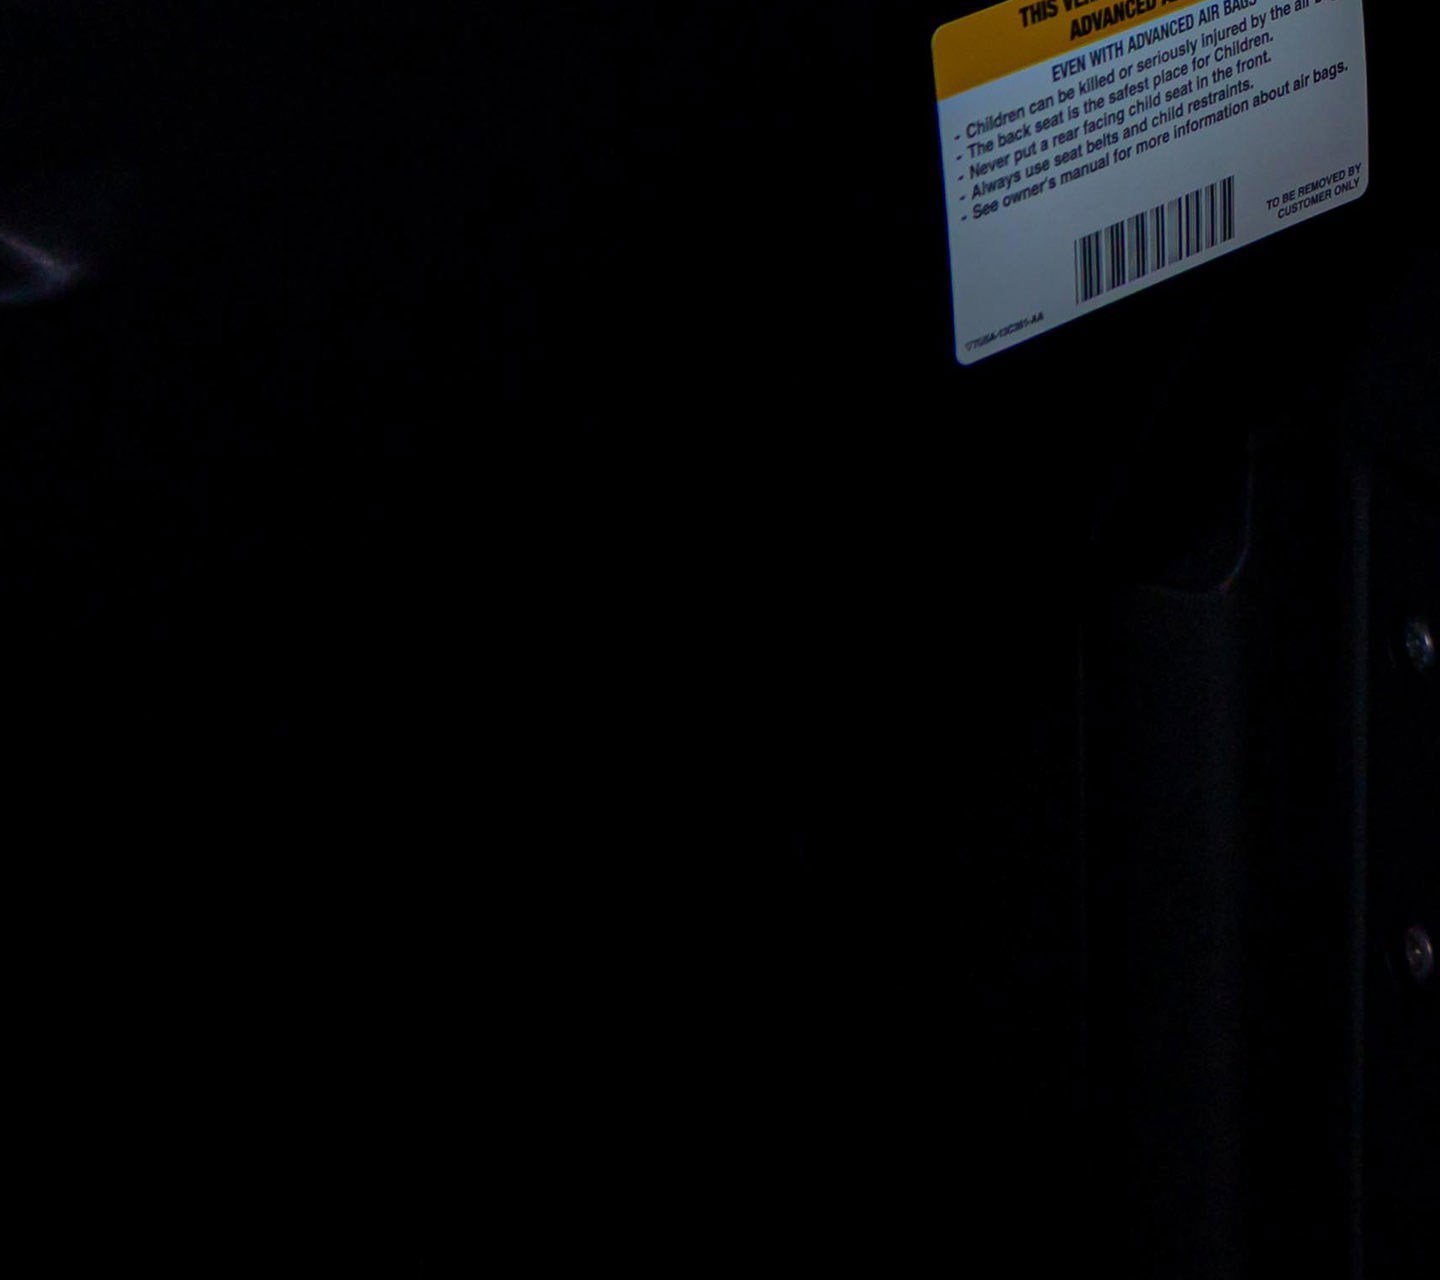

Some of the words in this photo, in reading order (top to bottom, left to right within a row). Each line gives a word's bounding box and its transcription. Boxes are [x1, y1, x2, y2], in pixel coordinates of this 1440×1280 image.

[966, 106, 1026, 139] Children
[1029, 96, 1054, 115] can
[1058, 87, 1075, 103] be
[1079, 71, 1115, 94] killed
[1119, 65, 1133, 80] or
[1137, 39, 1197, 73] seriously
[1201, 17, 1247, 48] injured
[1251, 11, 1267, 29] by
[1270, 4, 1291, 21] the
[967, 138, 994, 159] The
[998, 124, 1031, 148] back
[1035, 112, 1064, 133] seat
[1067, 106, 1079, 121] is
[1084, 96, 1105, 114] the
[1108, 77, 1149, 104] safest
[1153, 63, 1188, 90] place
[1192, 53, 1210, 71] for
[1214, 31, 1274, 63] Children.
[1051, 54, 1086, 82] EVEN
[1089, 41, 1124, 67] WITH
[1127, 13, 1194, 53] ADVANCED
[1198, 3, 1220, 26] AIR
[969, 154, 1009, 180] Never
[1013, 143, 1037, 166] put
[1040, 137, 1048, 148] a
[1051, 127, 1079, 147] rear
[1084, 110, 1125, 134] facing
[1128, 91, 1160, 116] child
[1165, 81, 1193, 102] seat
[1196, 75, 1208, 90] in
[1212, 67, 1233, 84] the
[1236, 50, 1272, 74] front.
[972, 170, 1021, 200] Always
[1025, 160, 1050, 178] use
[1054, 145, 1083, 167] seat
[1086, 131, 1119, 154] belts
[1122, 119, 1147, 140] and
[1151, 105, 1183, 128] child
[1187, 79, 1254, 113] restraints.
[973, 199, 998, 220] See
[1002, 176, 1056, 208] owner's
[1060, 152, 1110, 185] manual
[1113, 146, 1132, 164] for
[1136, 132, 1169, 155] more
[1173, 99, 1249, 139] information
[1253, 81, 1290, 108] about
[1293, 73, 1310, 91] air
[1313, 61, 1348, 84] bags.
[1265, 197, 1280, 211] TO
[1282, 190, 1296, 204] BE
[1297, 171, 1345, 197] REMOVED
[1348, 162, 1362, 176] BY
[1277, 188, 1332, 219] CUSTOMER
[1334, 177, 1360, 195] ONLY
